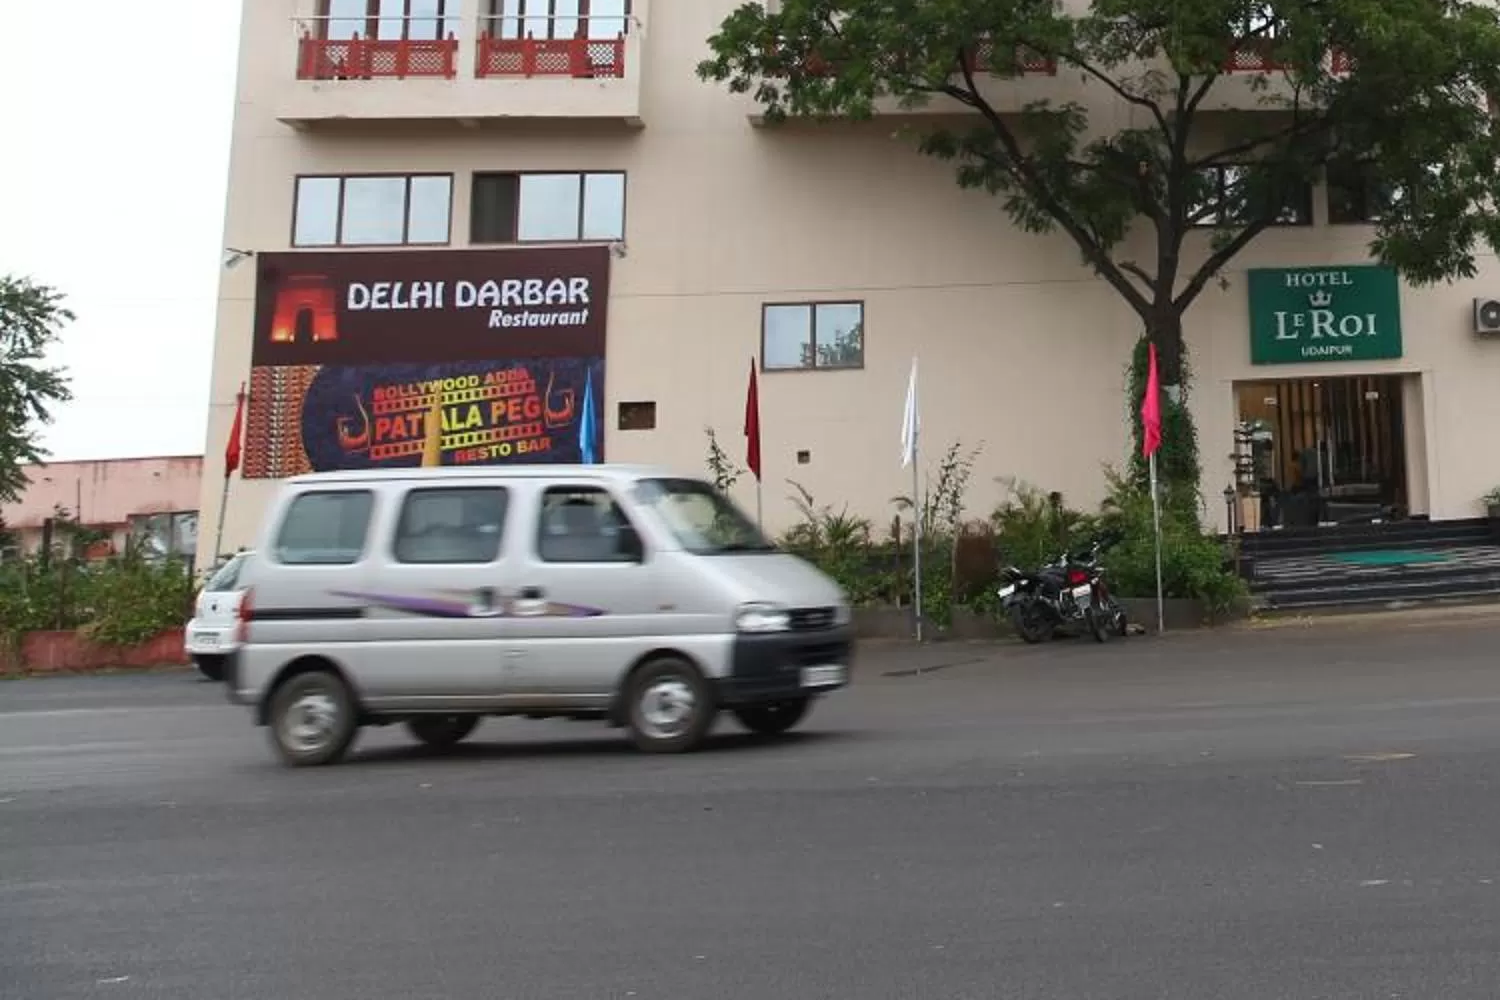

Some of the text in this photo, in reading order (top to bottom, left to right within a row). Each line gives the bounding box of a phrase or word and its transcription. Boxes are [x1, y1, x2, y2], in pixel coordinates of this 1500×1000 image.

[1286, 271, 1354, 287] HOTEL
[347, 277, 589, 310] DELHI DARBAR
[488, 309, 589, 329] Restaurant
[1310, 309, 1377, 339] ROI
[1301, 344, 1353, 357] UDAIPUR
[373, 375, 480, 403] BOLLYWOOD
[375, 395, 541, 441] PATLA PEG
[454, 437, 552, 462] RESTO BAR
